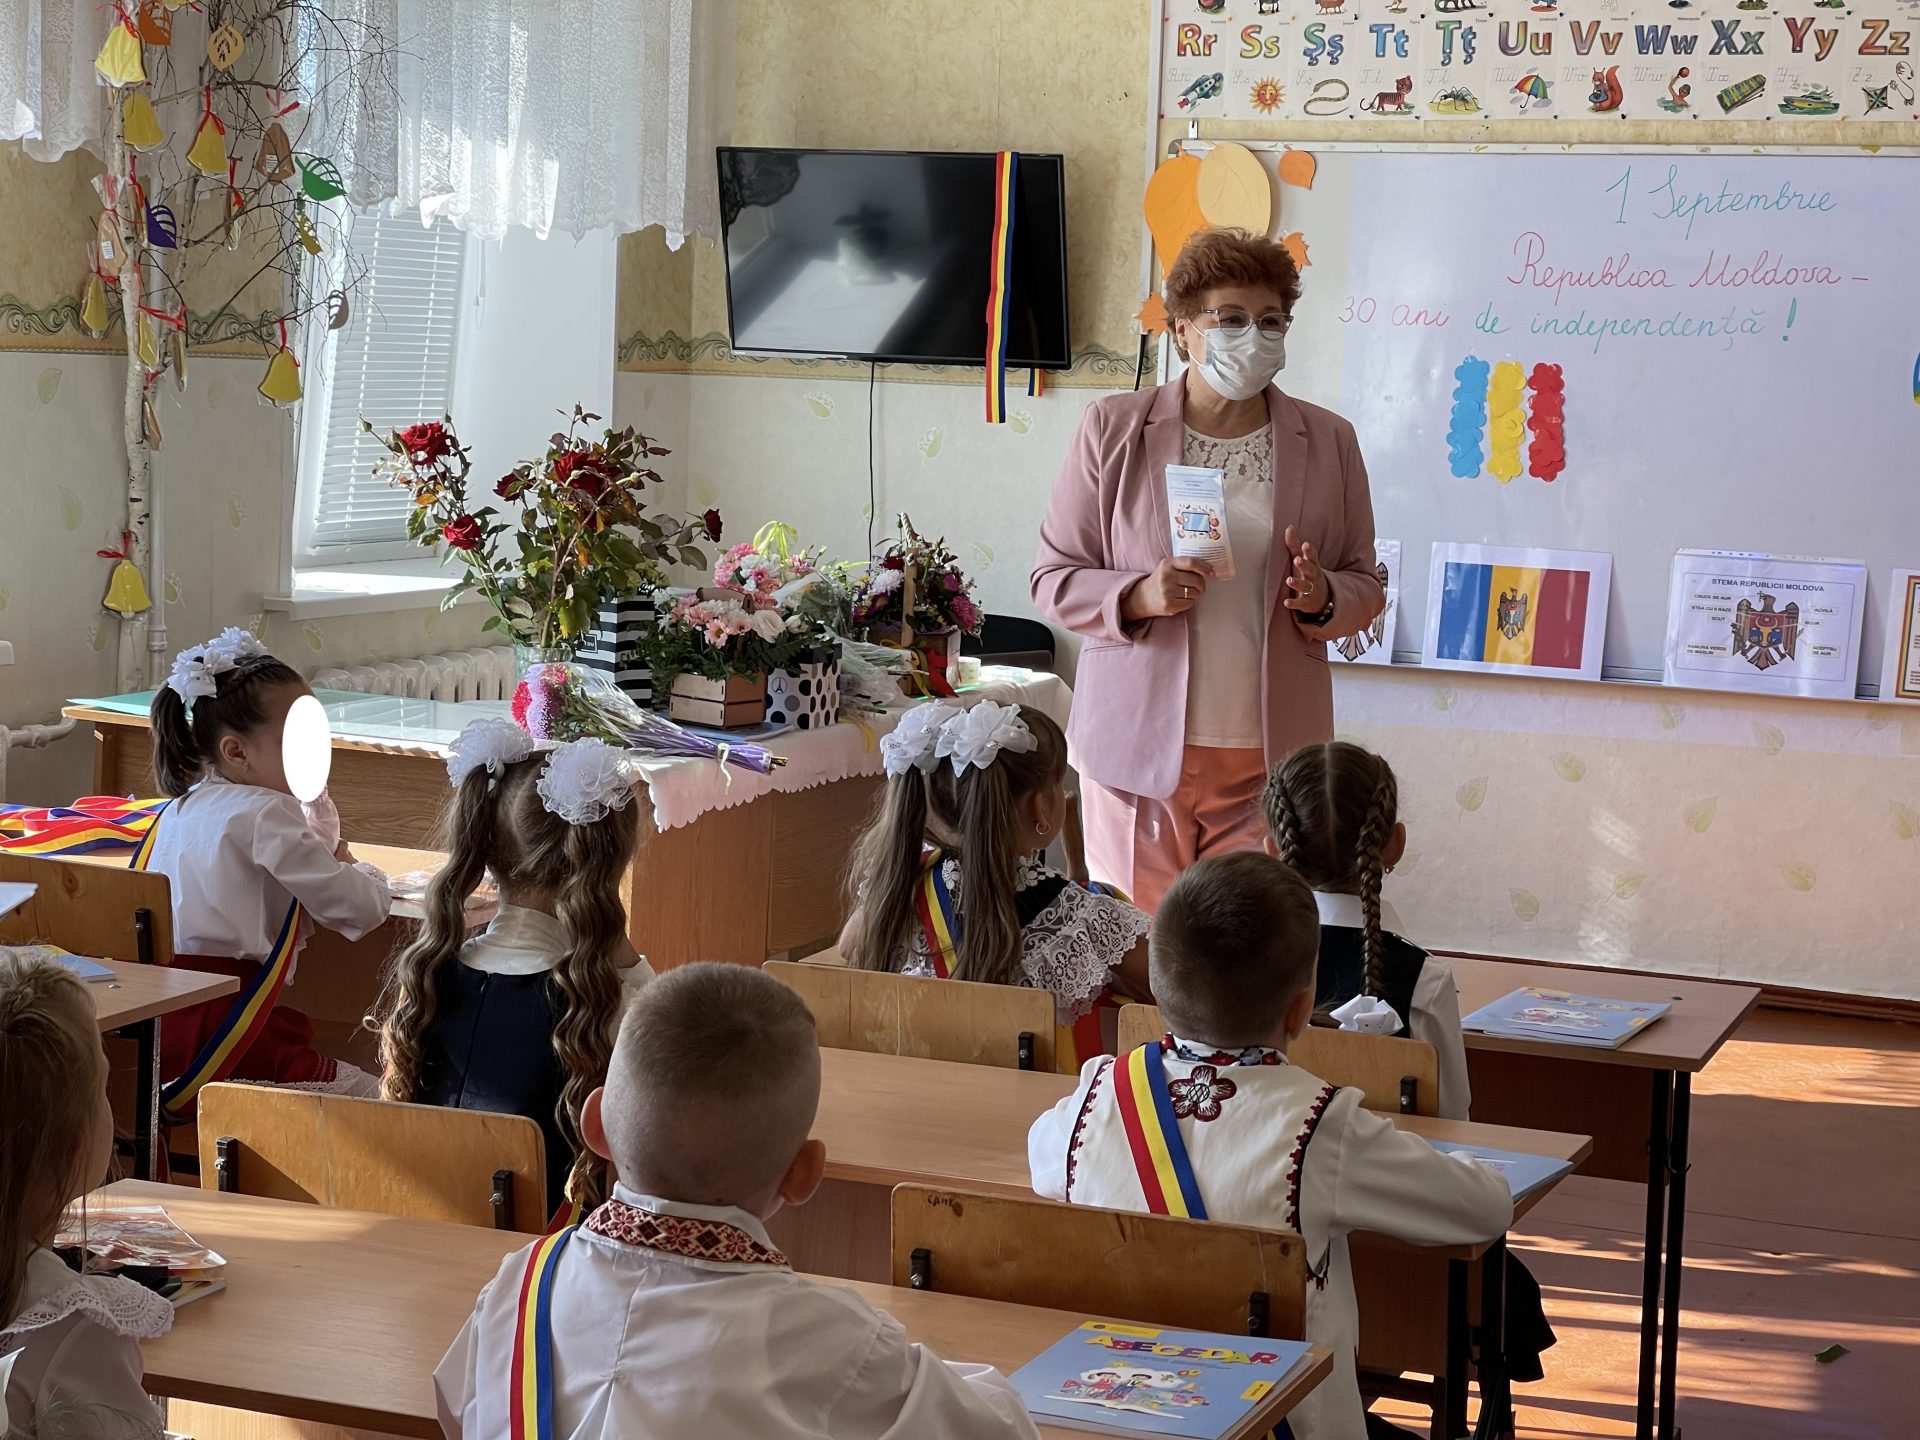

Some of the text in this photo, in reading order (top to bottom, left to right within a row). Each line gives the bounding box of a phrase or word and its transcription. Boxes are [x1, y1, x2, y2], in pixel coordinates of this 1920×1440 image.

[1177, 22, 1217, 57] Rr
[1240, 24, 1280, 58] Ss
[1369, 24, 1409, 58] Tt
[1498, 20, 1552, 56] Uu
[1569, 20, 1623, 55] Vv
[1634, 24, 1699, 55] Ww
[1708, 19, 1764, 55] Xx
[1784, 17, 1839, 61] Yy
[1858, 18, 1911, 55] Zz
[1604, 164, 1837, 240] 1 Septembrie
[1507, 231, 1676, 306] Republica
[1688, 249, 1841, 288] Moldova
[1337, 296, 1377, 324] 30
[1391, 304, 1449, 328] ani
[1475, 301, 1511, 335] de
[1711, 578, 1824, 592] STEMA REPUBLICII MOLDOVA
[1085, 1335, 1281, 1365] ABECEDAR
